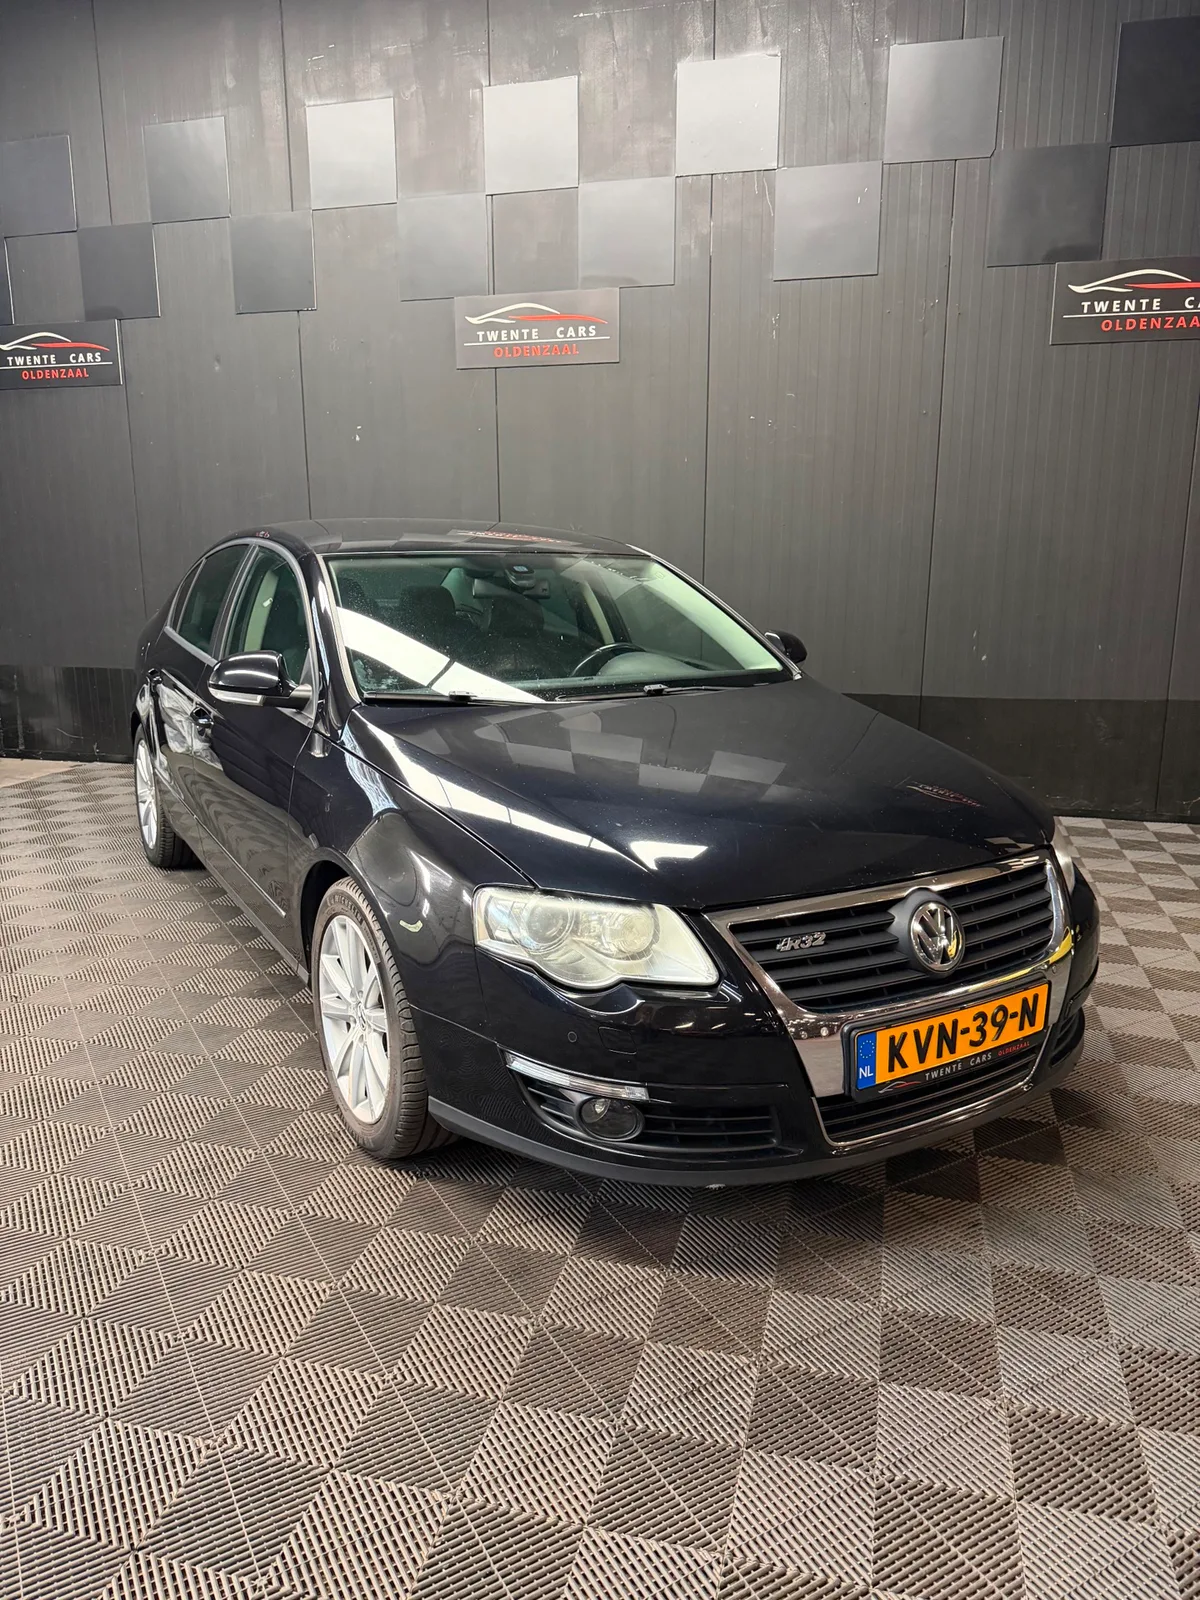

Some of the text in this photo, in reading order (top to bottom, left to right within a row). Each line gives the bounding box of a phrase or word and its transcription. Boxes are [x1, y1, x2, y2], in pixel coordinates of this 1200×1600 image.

[1081, 296, 1200, 313] TWENTE C
[477, 325, 597, 342] TWENTE CARS
[494, 344, 579, 358] OLDENZAAL
[7, 352, 102, 366] TWENTE CARS
[22, 368, 89, 380] OLDENZAAL
[887, 993, 1039, 1073] KVN-39-N
[925, 1041, 1030, 1081] TWENTE CARS OLDENZAAL
[859, 1065, 874, 1079] NL
